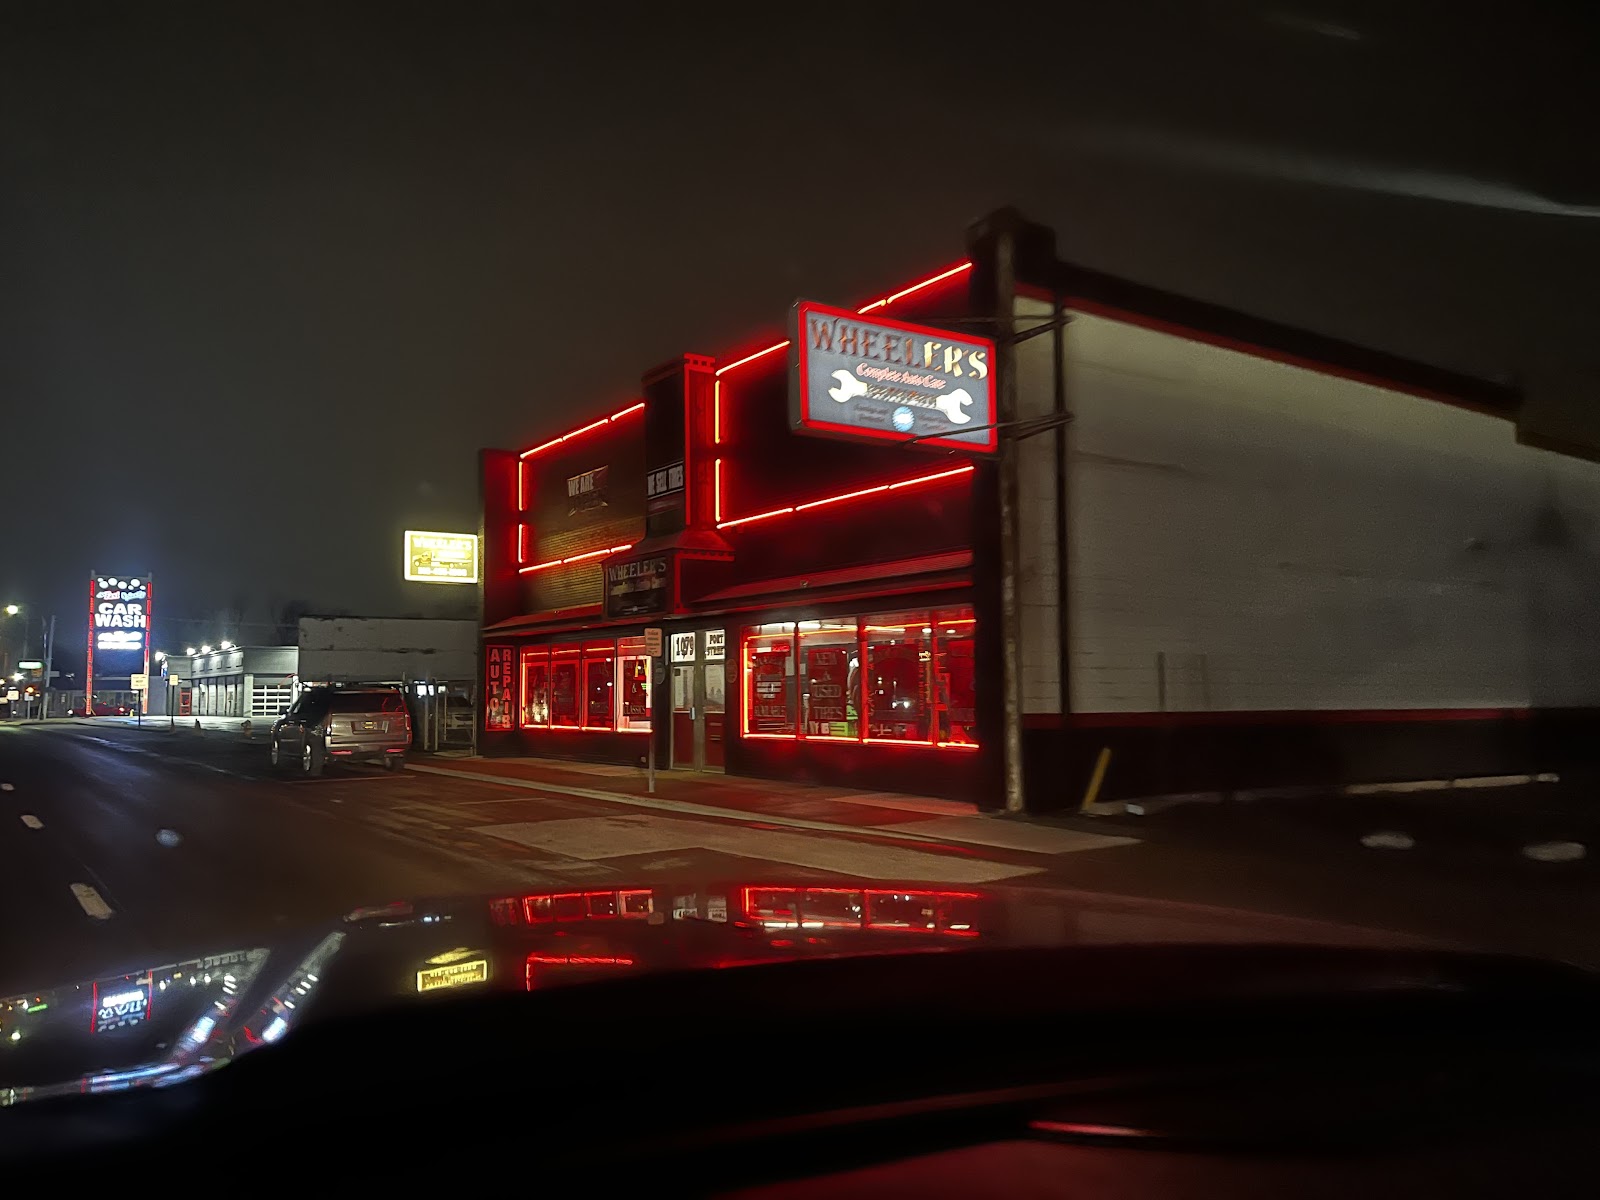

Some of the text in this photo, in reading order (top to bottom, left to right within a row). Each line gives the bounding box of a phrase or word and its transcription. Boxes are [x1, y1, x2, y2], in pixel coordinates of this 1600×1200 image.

[99, 602, 142, 615] CAR
[95, 613, 146, 628] WASH
[709, 634, 724, 645] PORT
[502, 648, 512, 729] REPAIR
